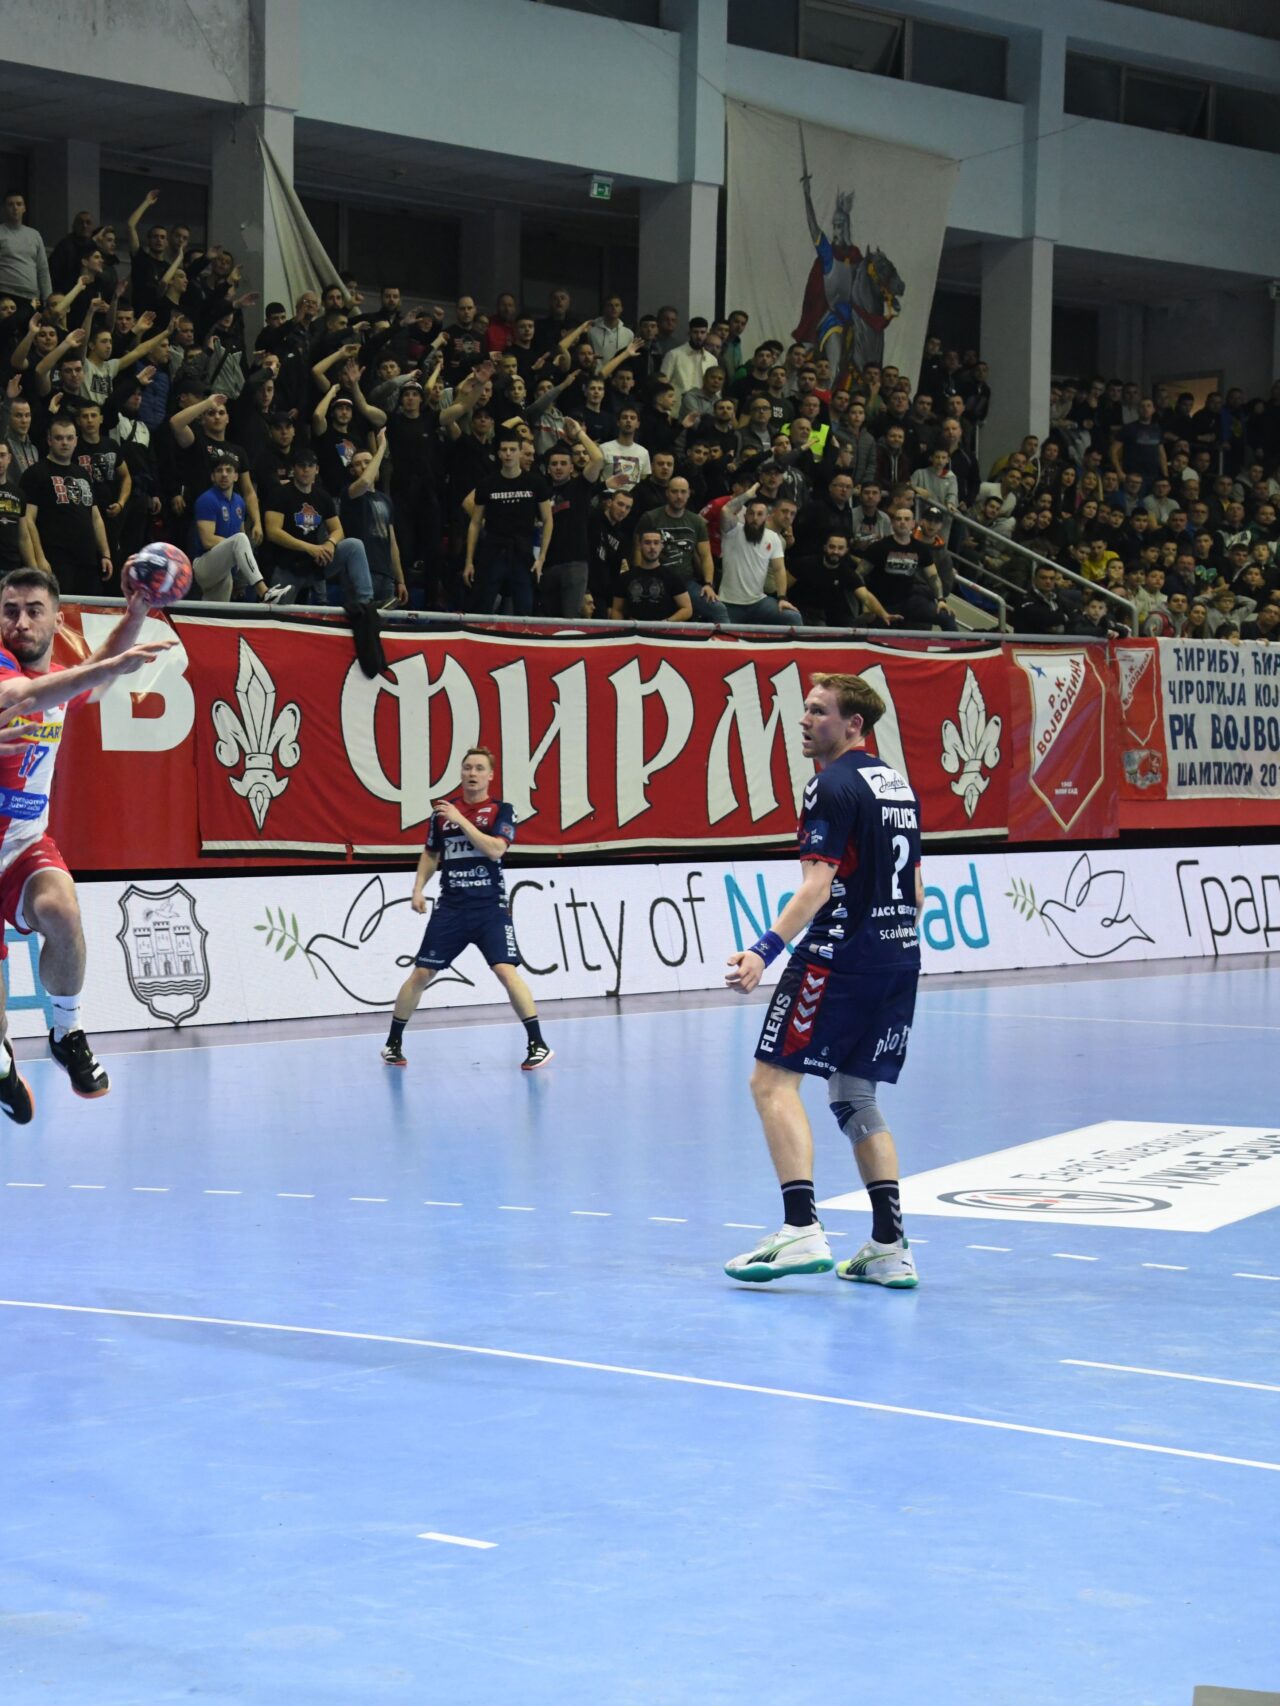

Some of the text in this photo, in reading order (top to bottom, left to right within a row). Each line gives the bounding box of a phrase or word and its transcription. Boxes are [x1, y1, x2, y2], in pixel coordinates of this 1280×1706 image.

[1036, 658, 1082, 756] ВОЈВОДИНА
[1169, 713, 1198, 750] РК
[18, 743, 50, 778] 17
[1260, 763, 1280, 787] 20
[452, 840, 475, 853] JYS
[891, 834, 910, 900] 2
[508, 880, 625, 997] City
[649, 871, 705, 967] of
[923, 862, 990, 951] ad
[871, 906, 896, 918] JACO
[504, 925, 517, 957] FLENS
[760, 993, 792, 1053] FLENS
